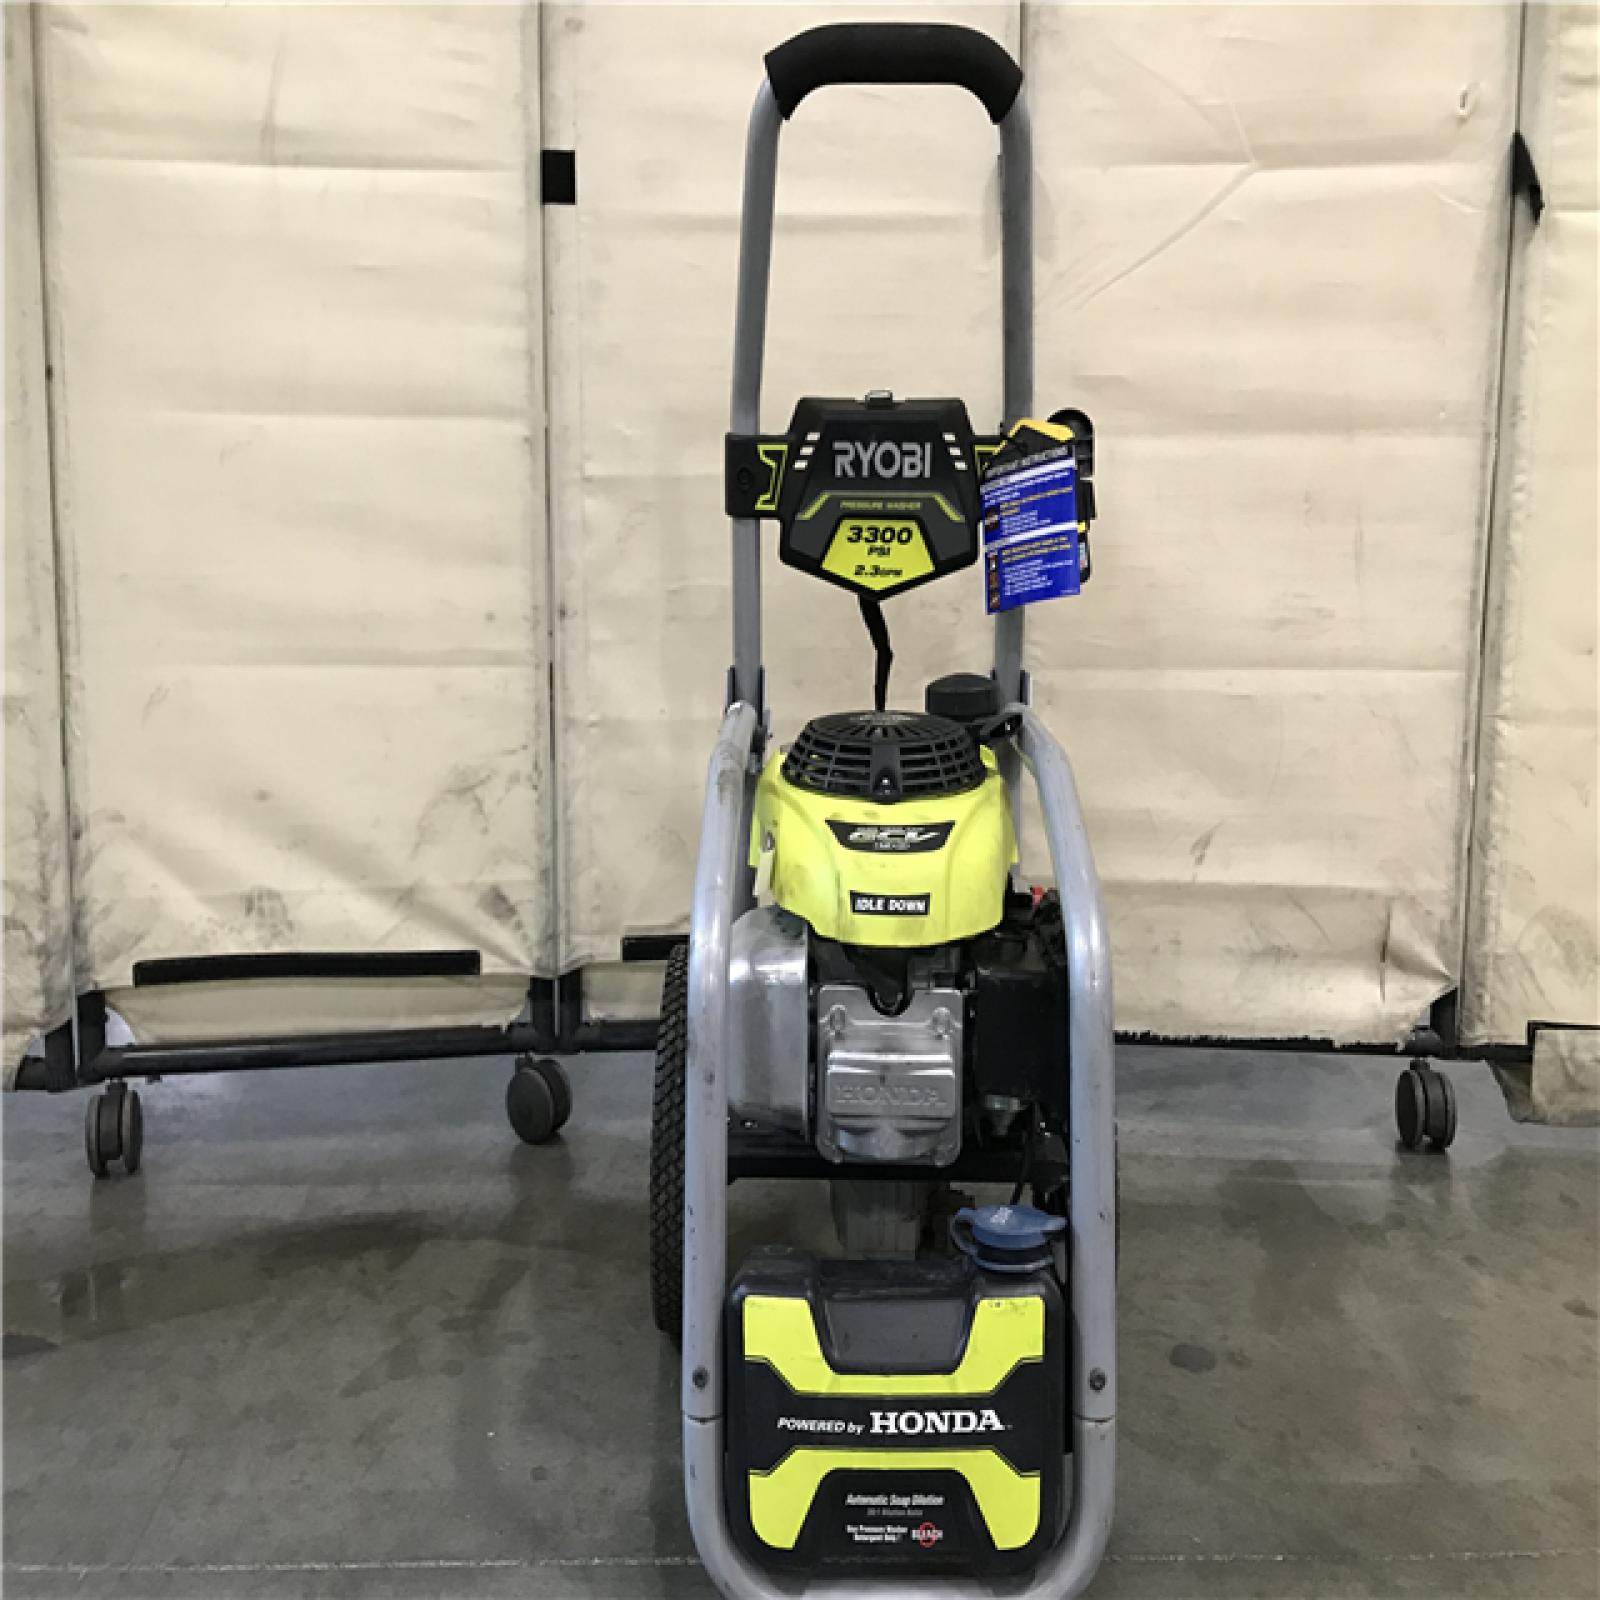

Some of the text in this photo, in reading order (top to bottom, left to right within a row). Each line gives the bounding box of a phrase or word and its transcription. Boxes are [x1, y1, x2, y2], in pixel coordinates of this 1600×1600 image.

[833, 441, 931, 478] RYOBI
[847, 525, 913, 544] 3300
[868, 546, 891, 557] PSI
[854, 897, 927, 912] IDLE DOWN
[835, 1085, 948, 1106] HONDA
[777, 1410, 1005, 1436] POWERED by HONDA
